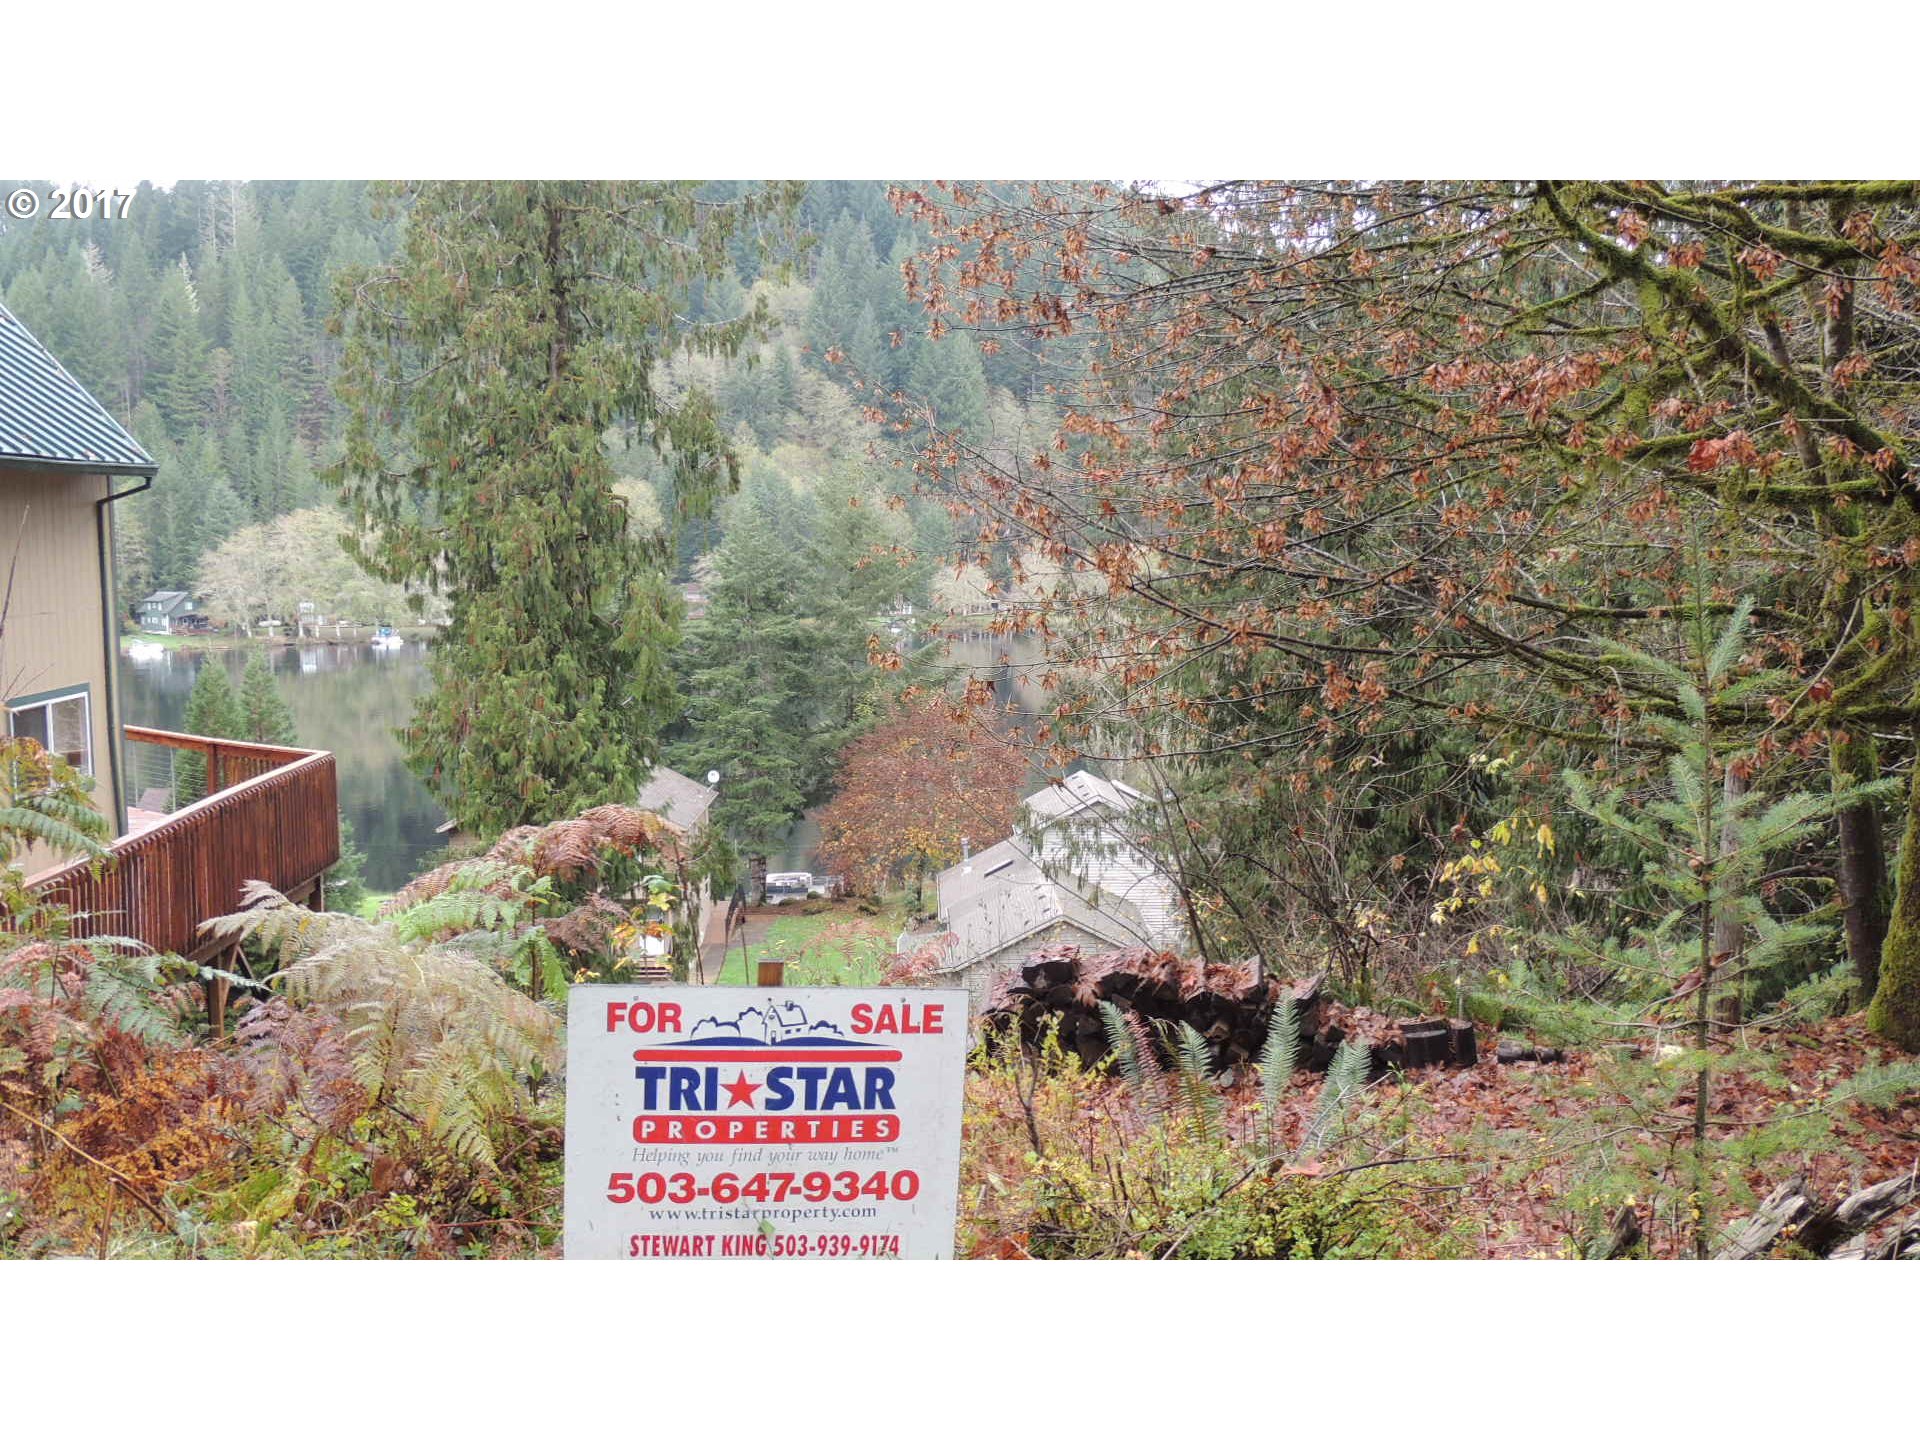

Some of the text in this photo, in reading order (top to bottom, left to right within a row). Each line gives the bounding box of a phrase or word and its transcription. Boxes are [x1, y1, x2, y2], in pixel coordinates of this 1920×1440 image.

[606, 1001, 945, 1035] FOR SALE
[635, 1066, 897, 1111] TRI STAR
[641, 1119, 891, 1140] PROPERTIES
[632, 1147, 691, 1166] Helping
[696, 1152, 725, 1167] you
[729, 1147, 763, 1167] find
[767, 1150, 801, 1167] your
[808, 1150, 838, 1166] way
[606, 1169, 920, 1204] 503-647-9340
[649, 1205, 877, 1223] www.tristarproperty.com
[629, 1233, 900, 1258] STEWART KING 503-939-9174
